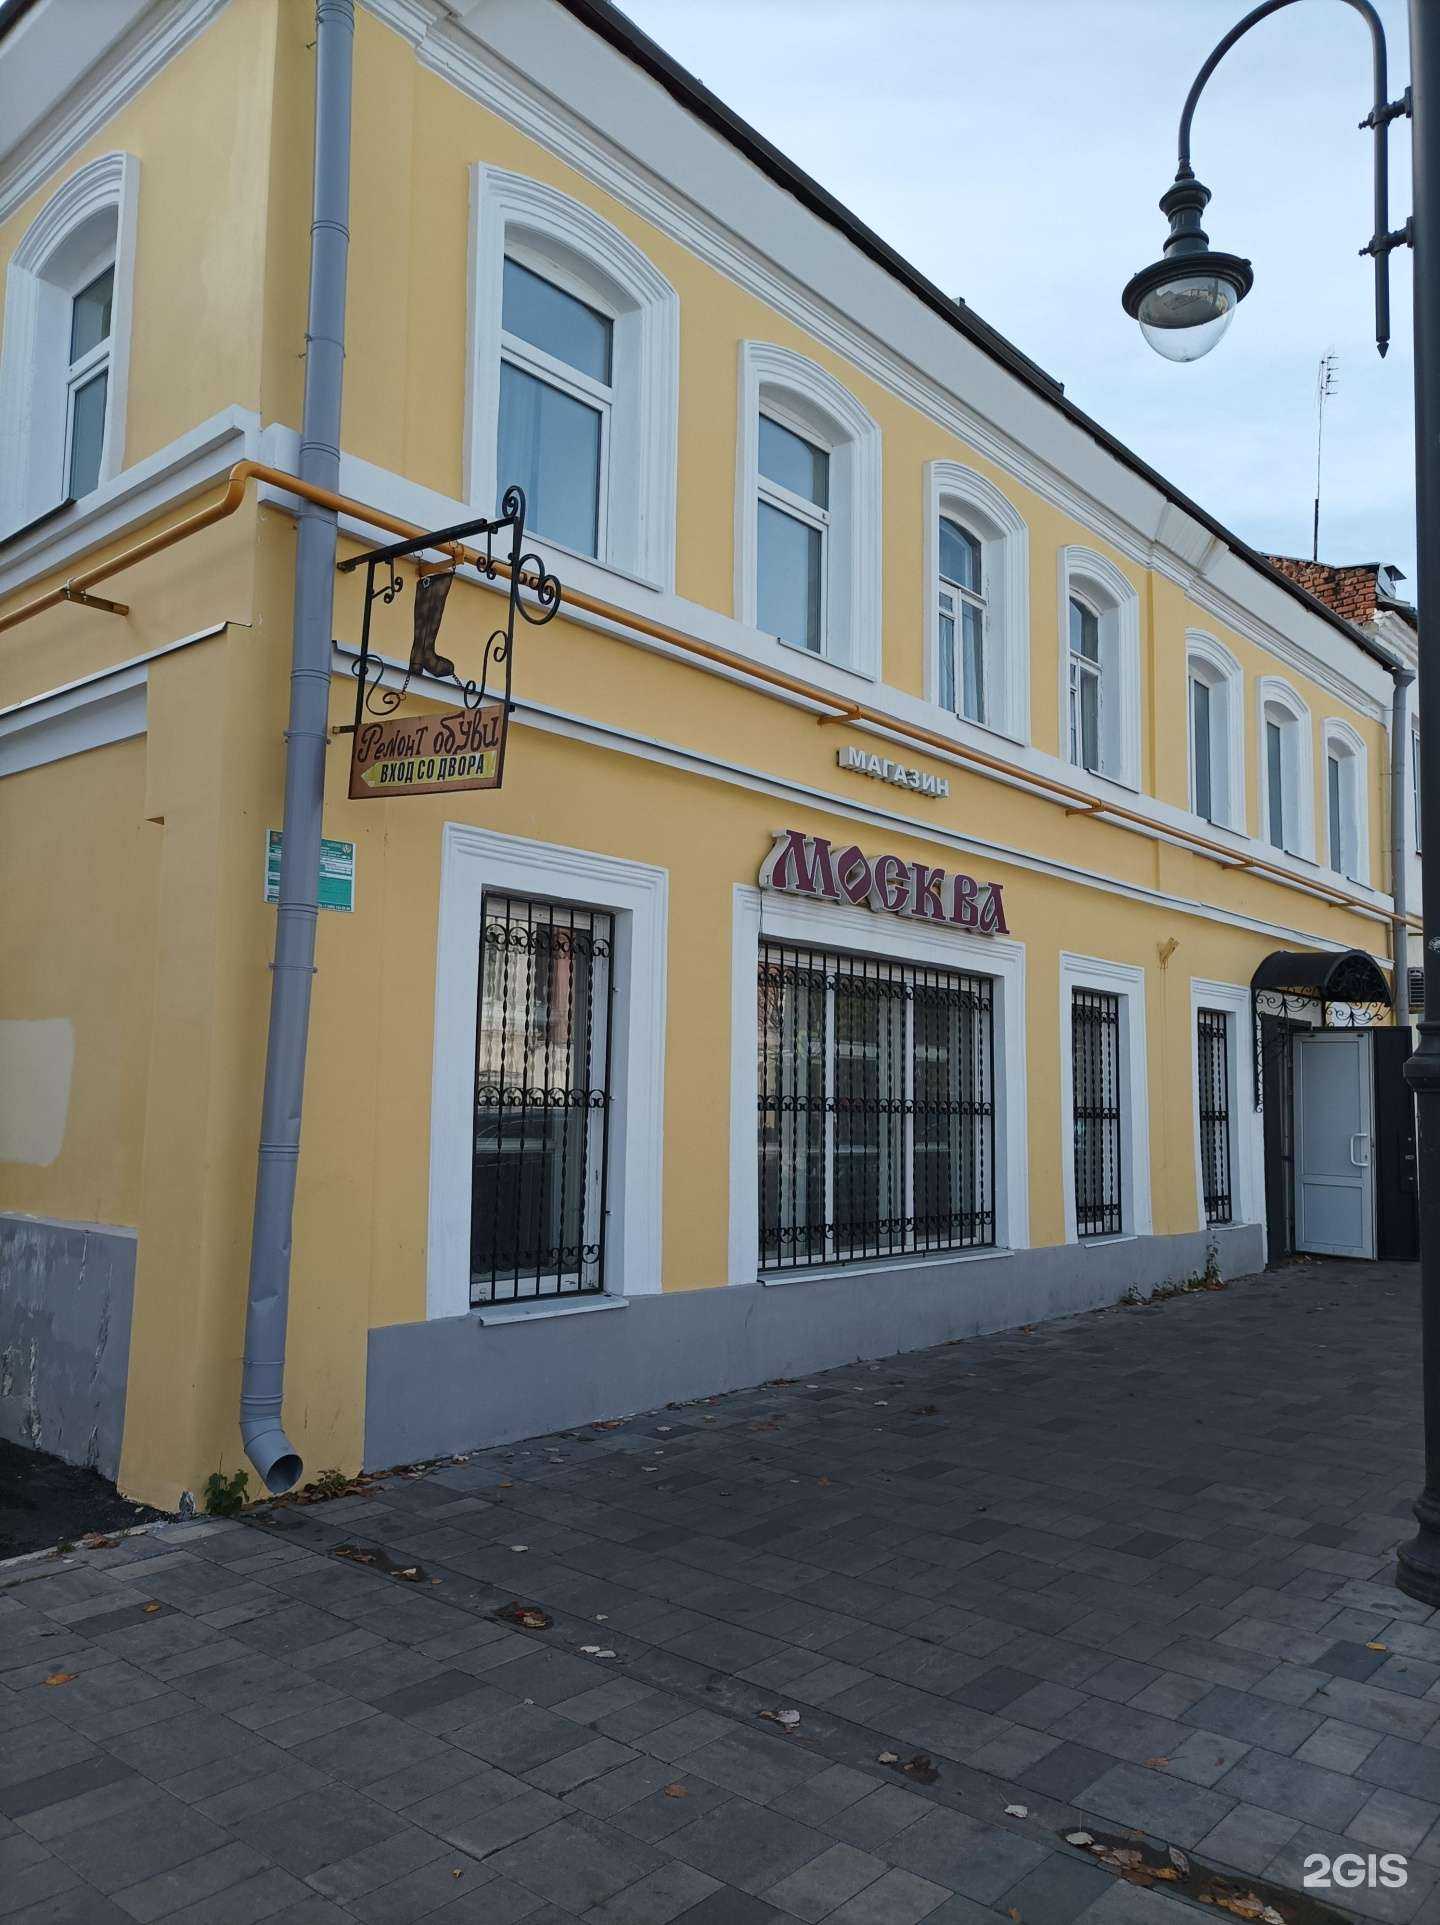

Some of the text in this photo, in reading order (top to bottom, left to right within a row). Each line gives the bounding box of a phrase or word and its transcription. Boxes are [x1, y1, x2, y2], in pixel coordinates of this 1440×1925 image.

[357, 723, 429, 763] Ремонт
[380, 754, 484, 784] ВХОД СО ДВОРА
[847, 745, 950, 798] МАГАЗИН
[771, 828, 1011, 935] МОСКВА
